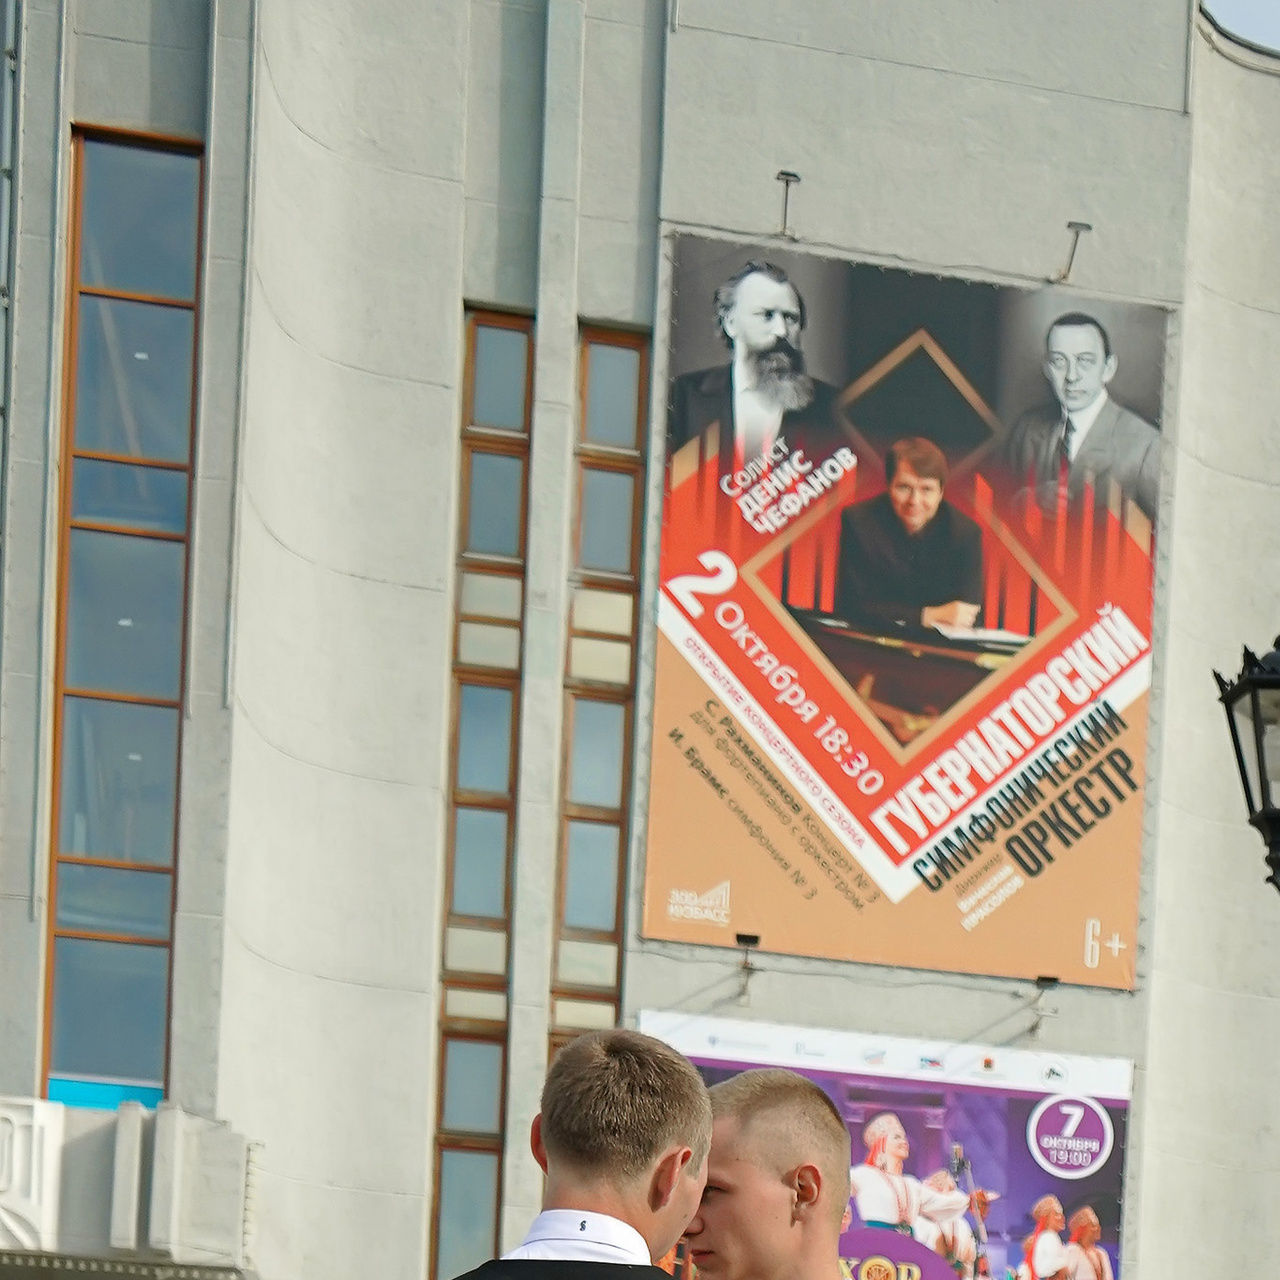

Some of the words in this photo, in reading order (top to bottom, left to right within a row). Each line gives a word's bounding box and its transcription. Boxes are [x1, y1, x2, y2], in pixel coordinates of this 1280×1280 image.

[719, 436, 790, 497] Солист
[736, 449, 814, 522] ДЕНИС
[750, 446, 858, 535] ЧЕФАНОВ
[664, 549, 739, 619] 2
[714, 600, 821, 724] Октября
[813, 713, 885, 796] 18:30
[719, 715, 803, 815] Рахманинов
[869, 601, 1150, 857] ГУБЕРНАТОРСКИЙ
[683, 747, 730, 800] Брамс
[912, 697, 1129, 893] СИМФОНИЧЕСКИЙ
[1005, 747, 1139, 878] ОРКЕСТР
[1040, 1134, 1100, 1153] ОКТЯБРЯ
[1049, 1149, 1092, 1167] 19:00
[1059, 1104, 1085, 1138] 7
